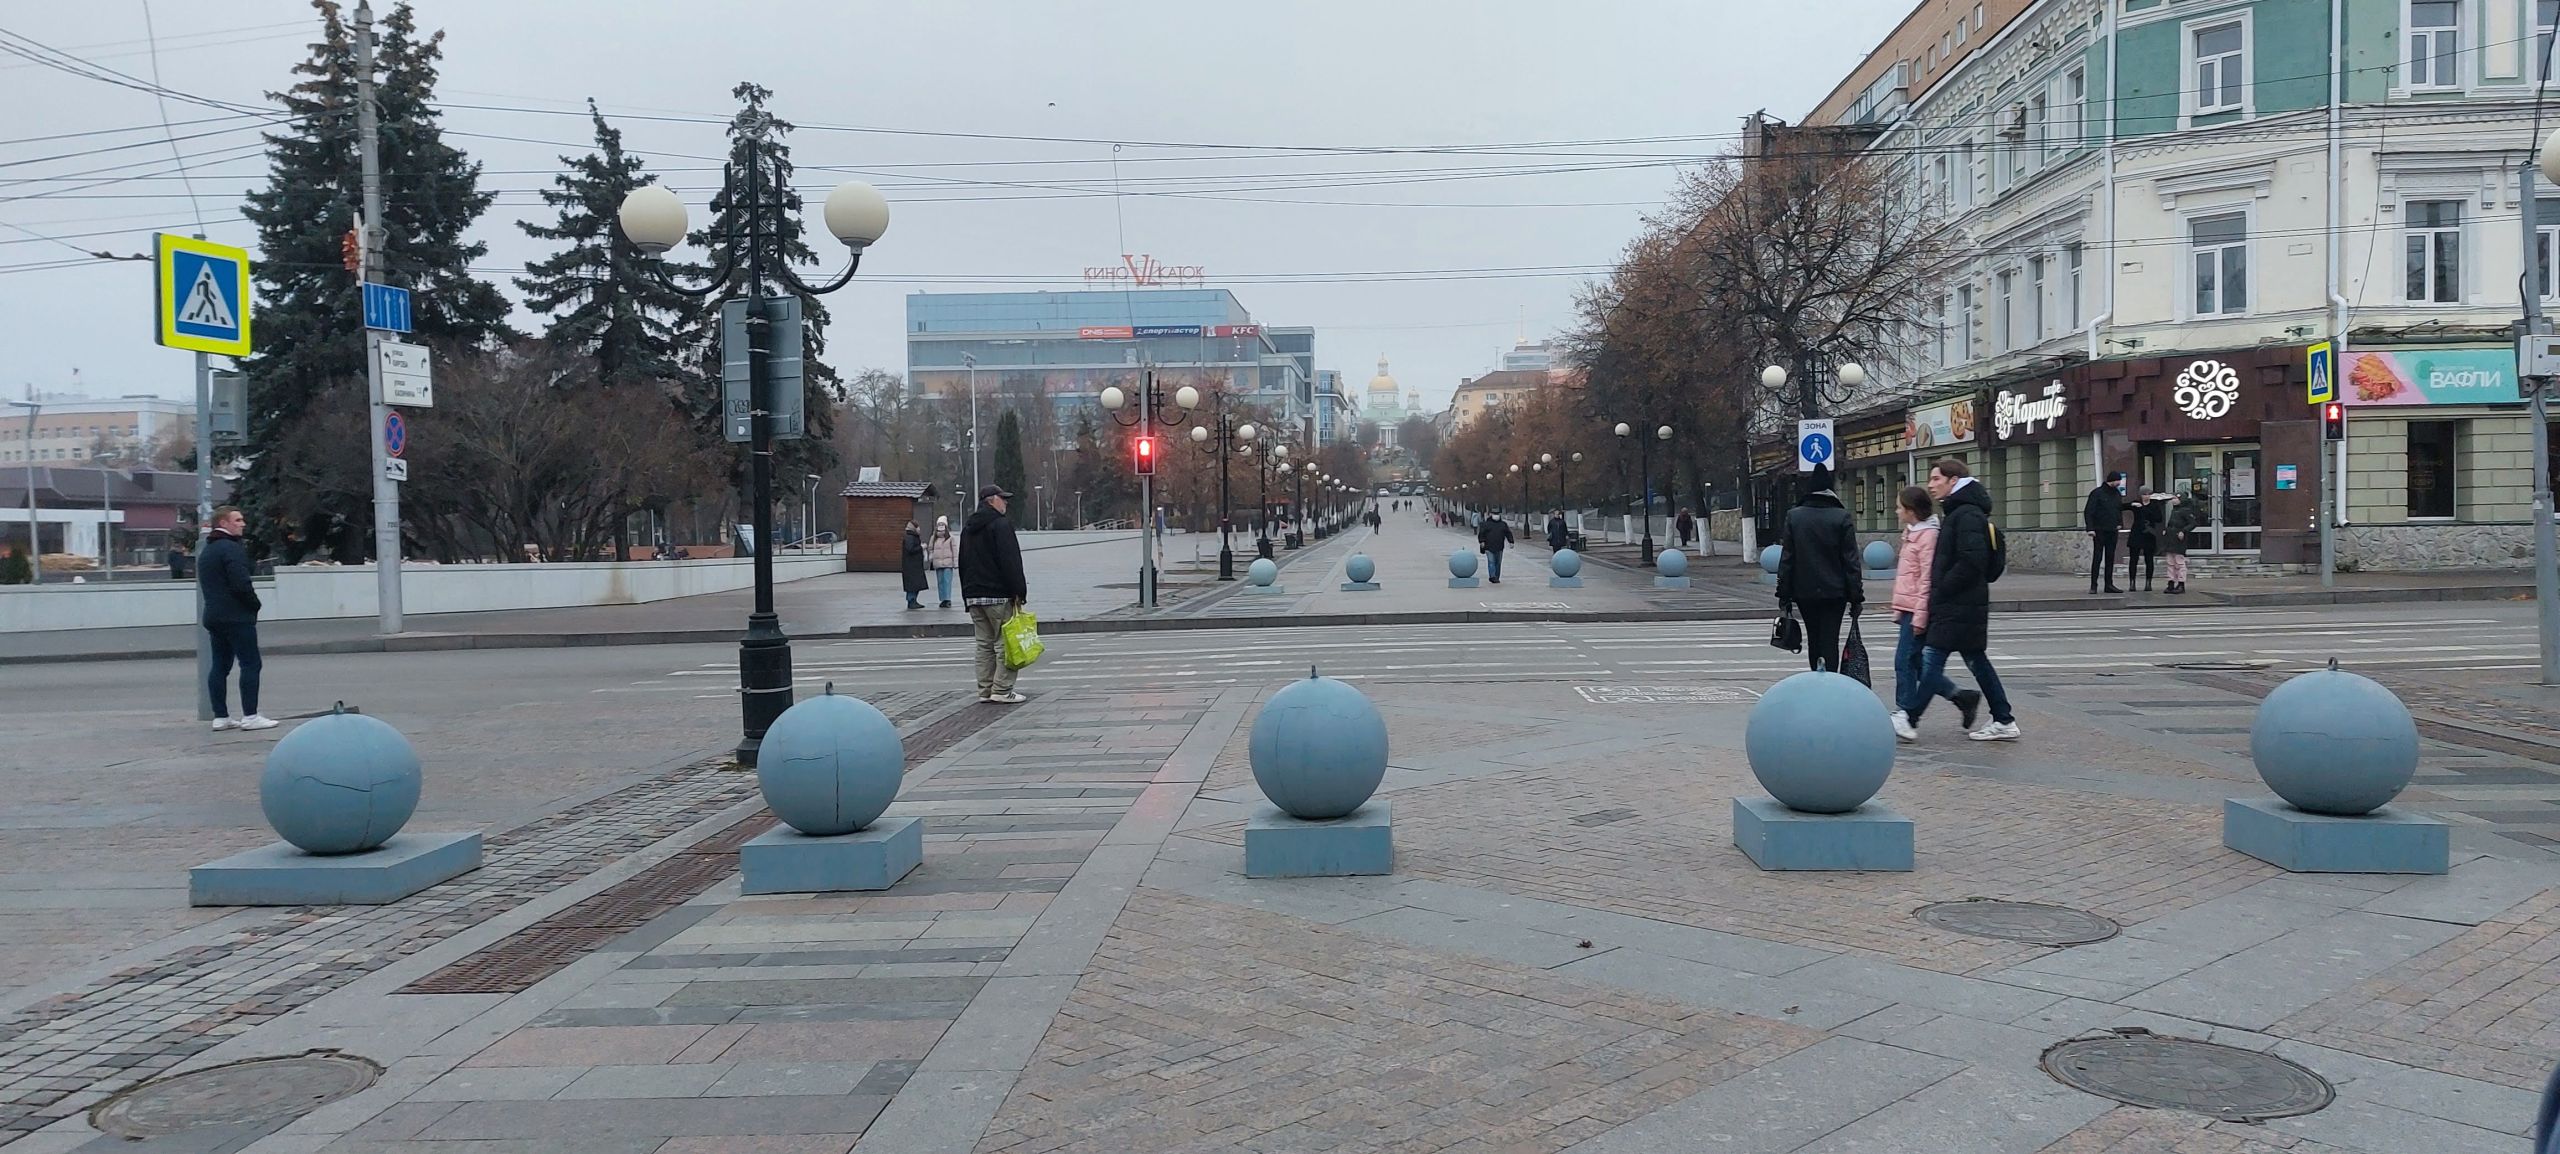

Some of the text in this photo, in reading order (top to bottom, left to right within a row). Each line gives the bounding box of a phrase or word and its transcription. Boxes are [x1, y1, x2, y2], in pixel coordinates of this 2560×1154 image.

[1084, 266, 1128, 280] КИНО
[1158, 265, 1204, 280] КАТОК
[1082, 328, 1104, 336] DNS
[1231, 326, 1254, 335] KFC
[2429, 370, 2500, 389] ВАФЛИ
[2012, 393, 2067, 435] Корица
[1804, 422, 1827, 430] ЗОНА
